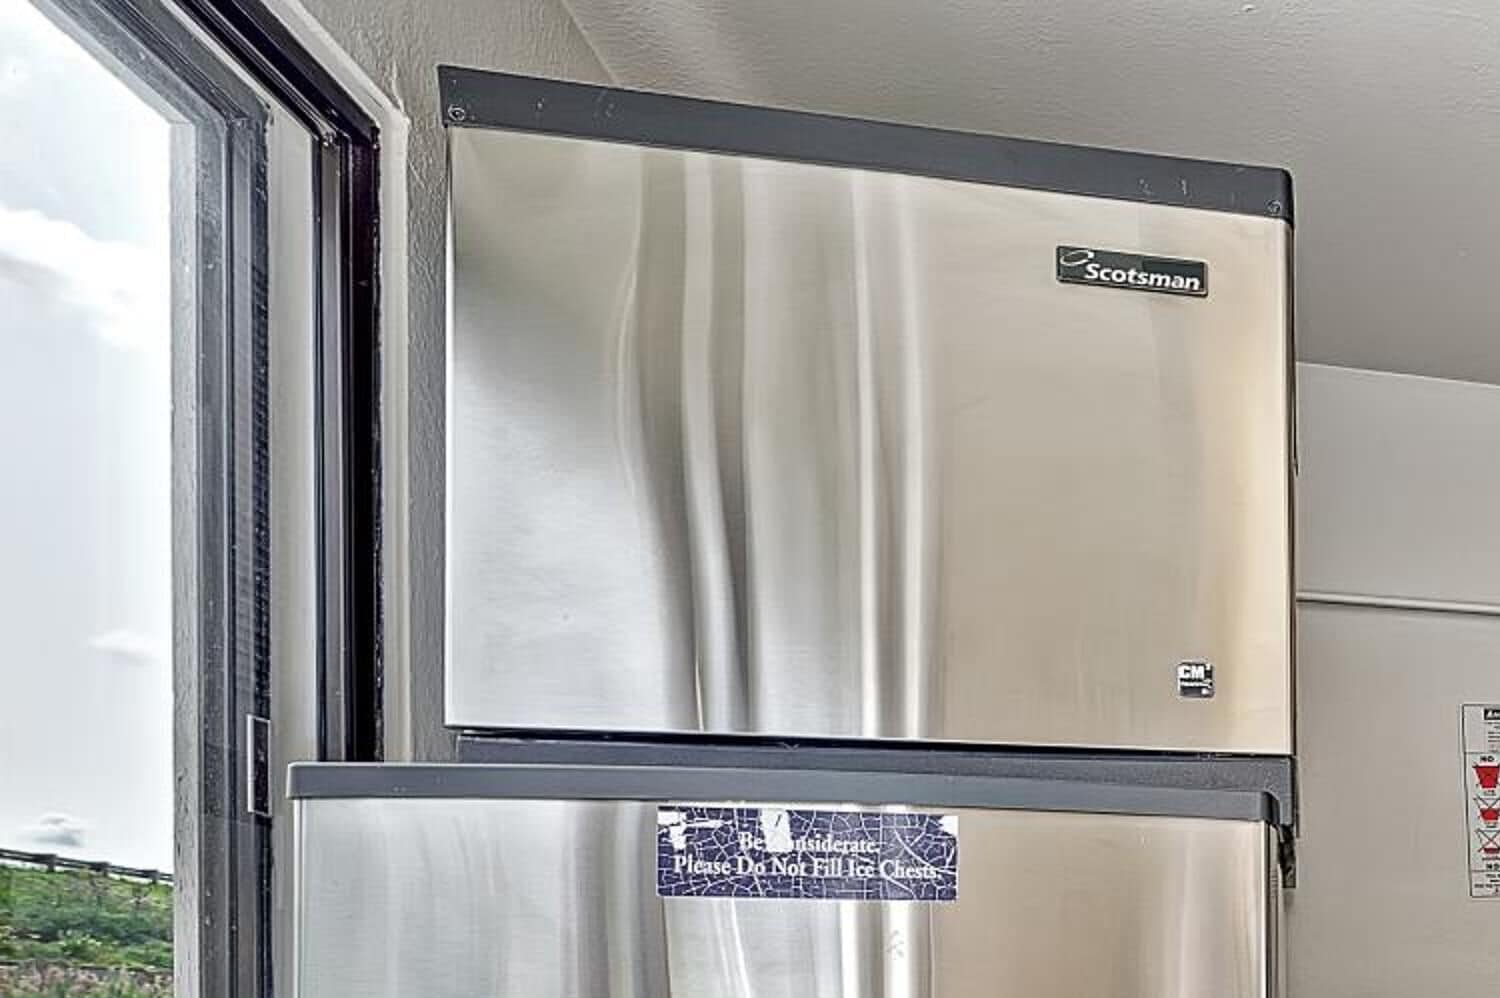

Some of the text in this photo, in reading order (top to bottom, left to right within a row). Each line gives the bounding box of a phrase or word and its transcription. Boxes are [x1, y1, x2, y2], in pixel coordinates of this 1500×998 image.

[1084, 263, 1200, 290] Scotsman
[738, 832, 881, 853] Be nsiderate.
[673, 855, 943, 880] Please Do Not Fill Ice Chests.
